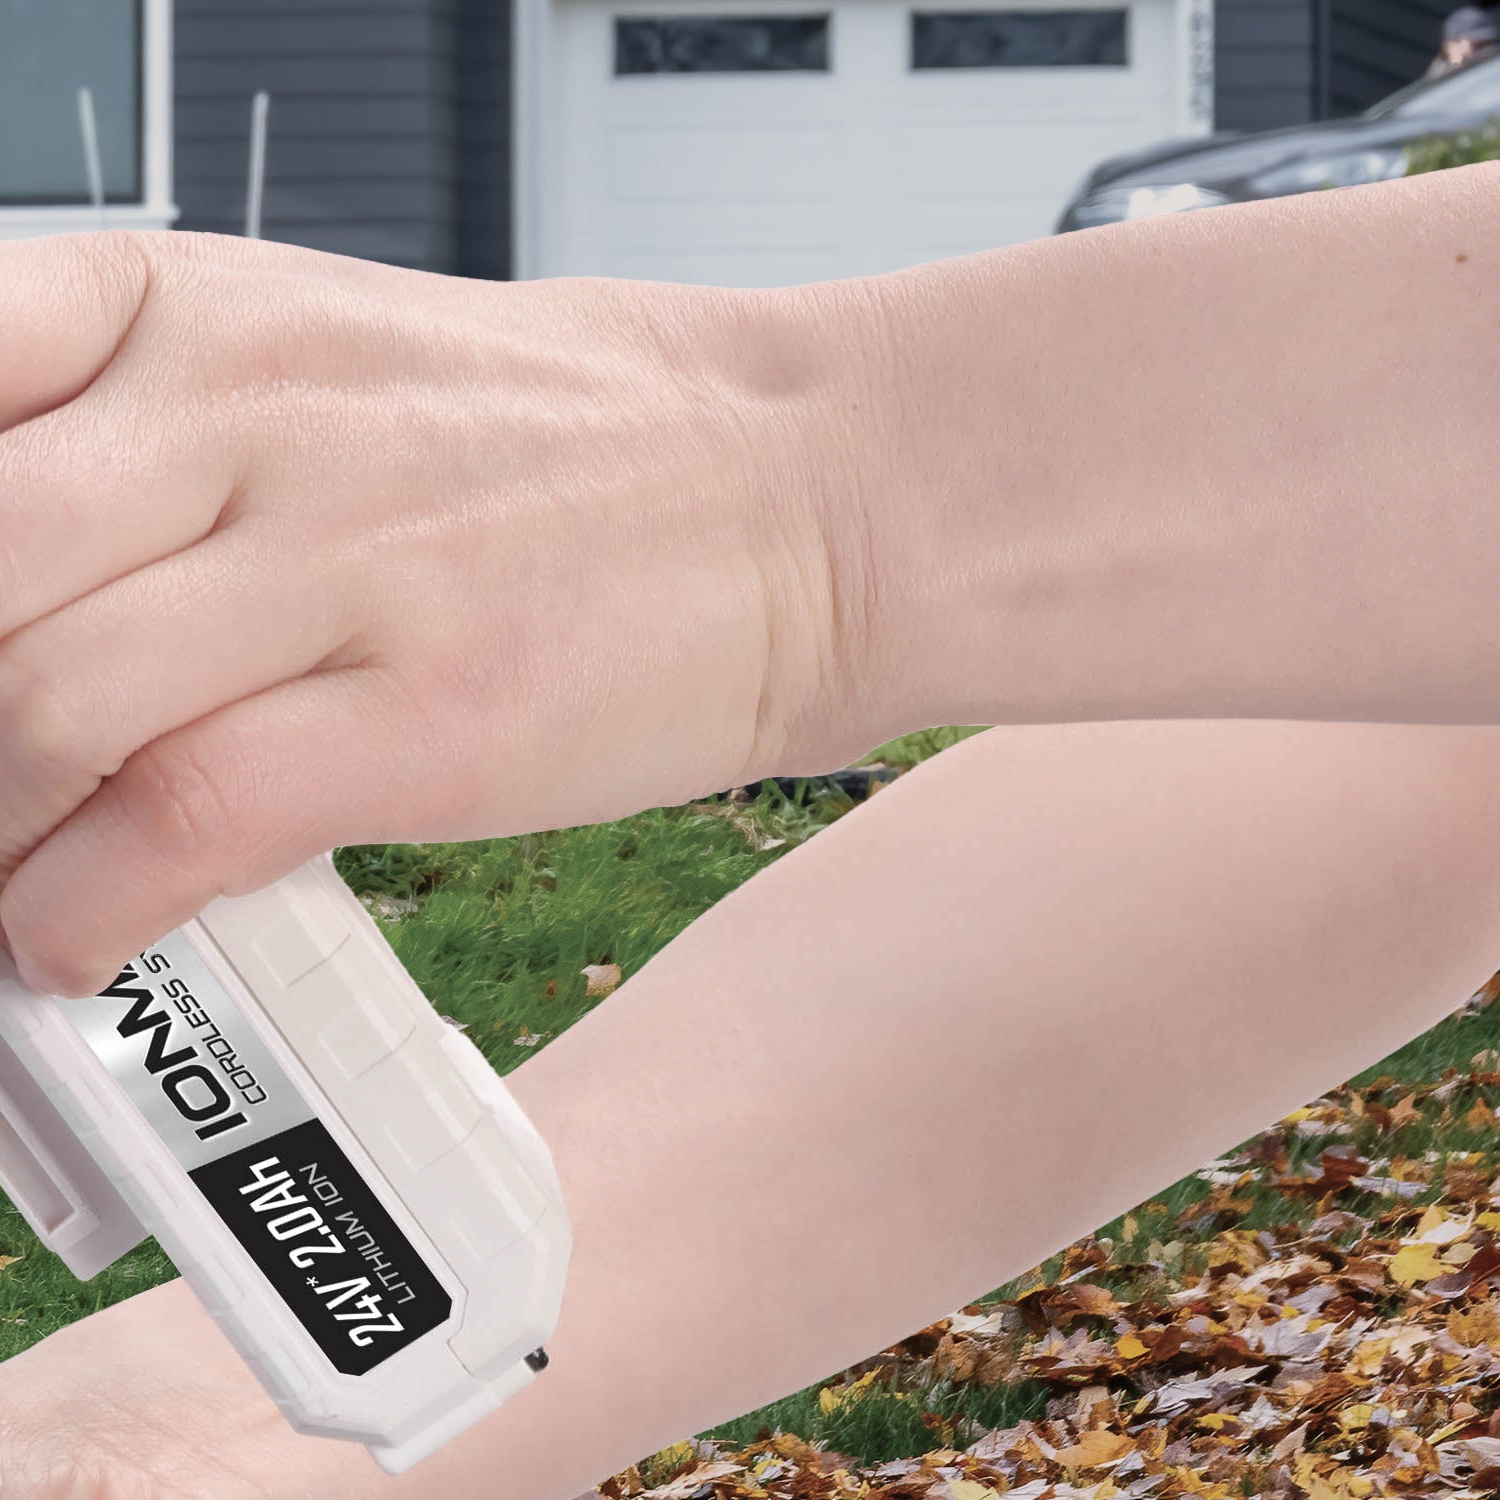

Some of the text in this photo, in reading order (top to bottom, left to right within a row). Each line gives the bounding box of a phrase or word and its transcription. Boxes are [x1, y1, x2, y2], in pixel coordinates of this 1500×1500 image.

[94, 962, 249, 1141] IONM
[160, 978, 268, 1105] CORDLESS
[238, 1156, 346, 1269] 2.0Ah
[298, 1161, 417, 1304] LITHIUM ION
